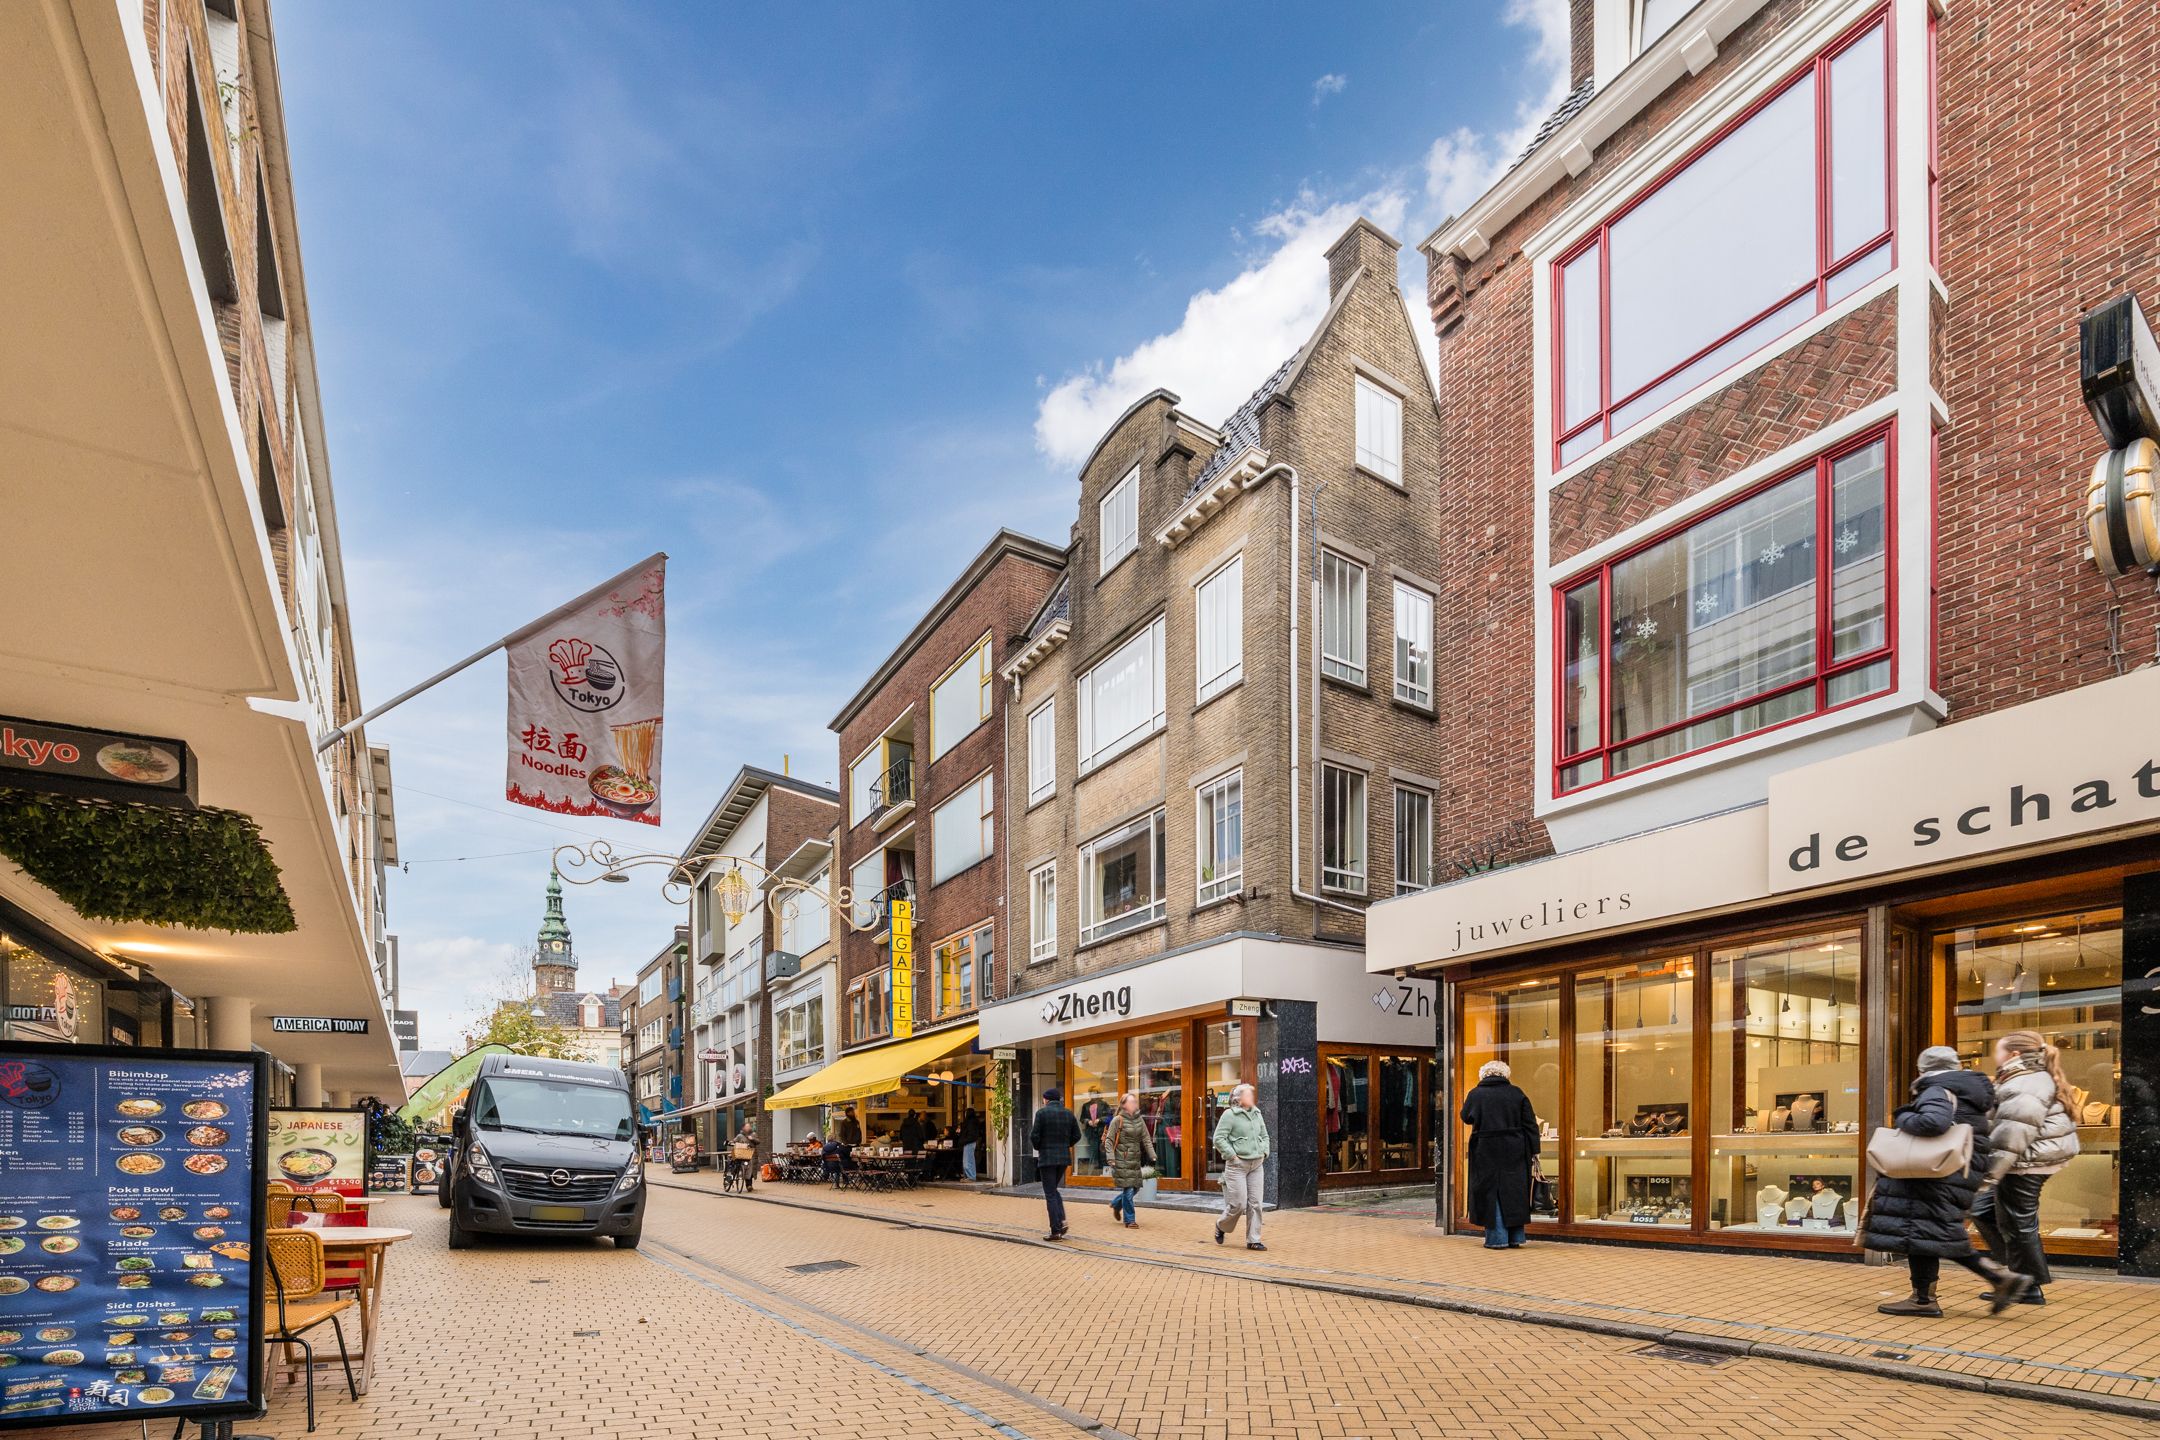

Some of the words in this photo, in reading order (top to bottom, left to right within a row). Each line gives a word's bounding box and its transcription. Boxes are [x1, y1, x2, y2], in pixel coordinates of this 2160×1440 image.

[568, 687, 610, 706] Tokyo
[0, 727, 80, 766] kyo
[521, 723, 587, 762] 拉面
[521, 753, 586, 778] Noodles
[1788, 832, 1868, 872] de
[1451, 893, 1631, 951] juweliers
[895, 903, 908, 1018] PIGALLE
[1057, 985, 1131, 1022] Zheng
[1239, 1003, 1260, 1014] Zheng
[1398, 985, 1436, 1017] Zh
[275, 1019, 330, 1031] AMERICA
[333, 1020, 365, 1031] TODAY
[109, 1070, 168, 1079] Bibimbap
[503, 1068, 544, 1076] SMEBA
[287, 1121, 343, 1130] JAPANESE
[281, 1131, 359, 1146] ラーメン
